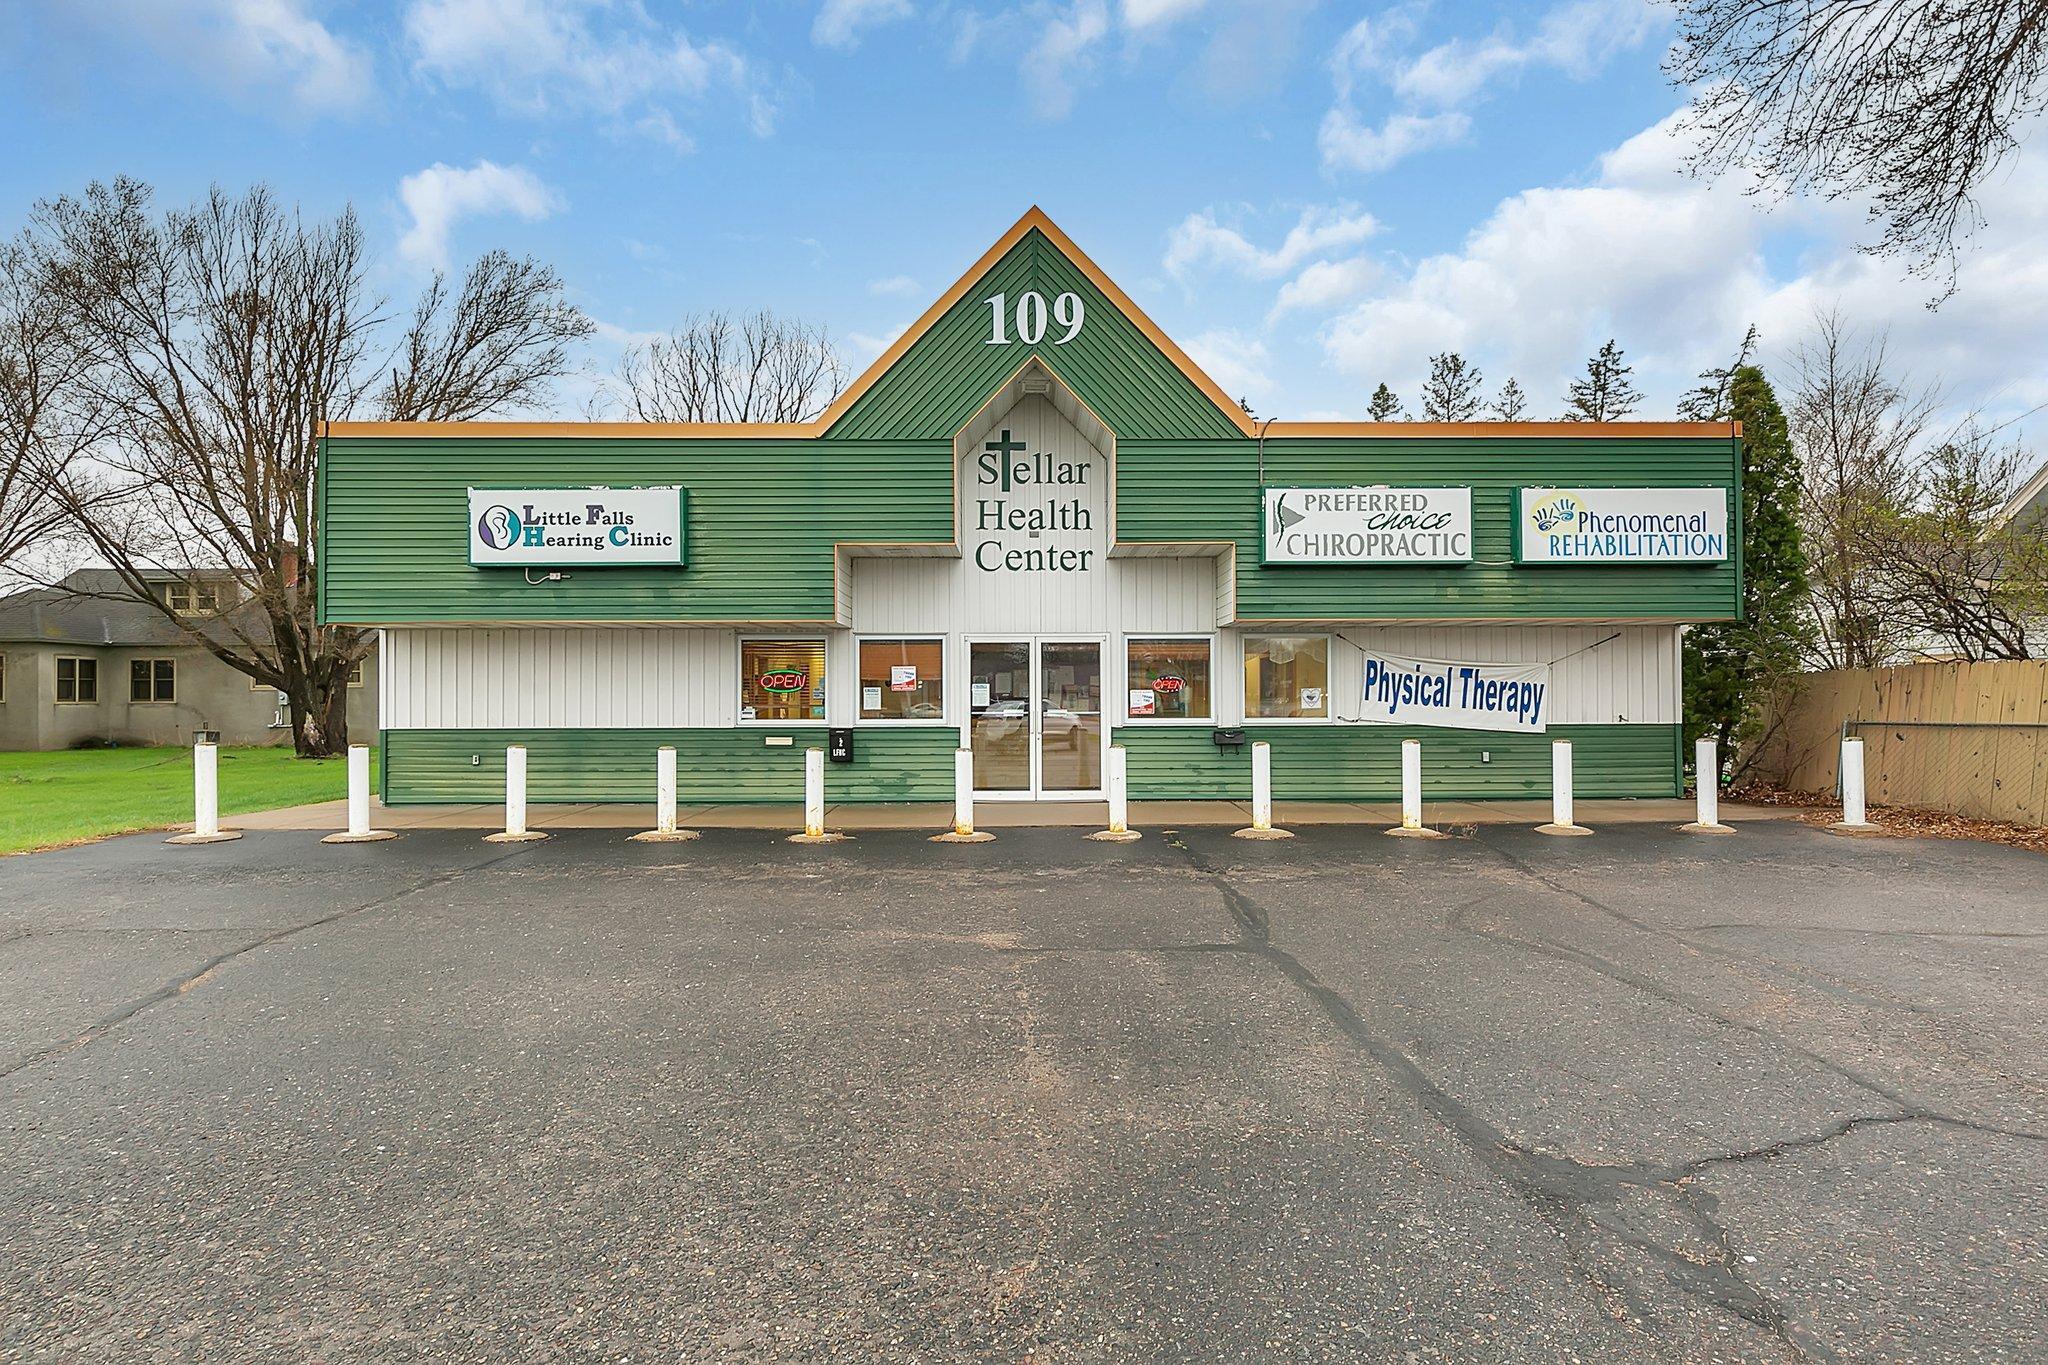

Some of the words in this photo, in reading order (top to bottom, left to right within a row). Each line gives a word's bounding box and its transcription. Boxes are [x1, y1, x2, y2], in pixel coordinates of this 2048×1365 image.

[983, 291, 1086, 346] 109
[977, 430, 1091, 492] Stellar
[1304, 494, 1428, 511] PREFERRED
[522, 505, 581, 525] Little
[585, 504, 634, 525] Falls
[975, 499, 1093, 531] Health
[1363, 511, 1452, 530] choice
[1578, 511, 1706, 533] Phenomenal
[522, 526, 605, 551] Hearing
[608, 525, 673, 547] Clinic
[1286, 533, 1466, 556] CHIROPRACTIC
[1550, 534, 1723, 556] REHABILITATION
[975, 540, 1093, 572] Center
[760, 674, 806, 688] OPEN
[1154, 679, 1184, 690] OPEN
[1364, 659, 1453, 715] Physical
[1459, 667, 1545, 725] Therapy
